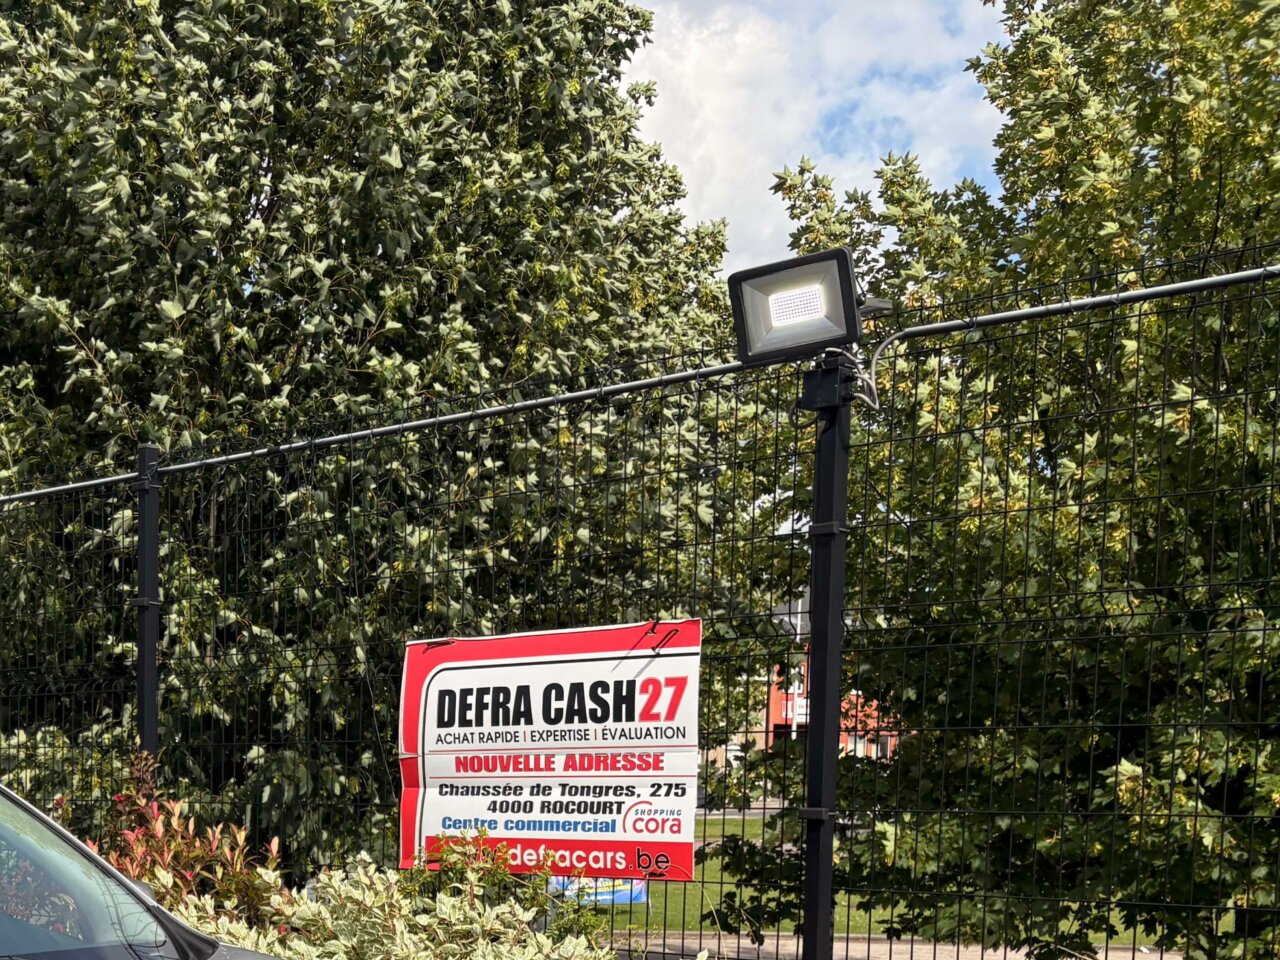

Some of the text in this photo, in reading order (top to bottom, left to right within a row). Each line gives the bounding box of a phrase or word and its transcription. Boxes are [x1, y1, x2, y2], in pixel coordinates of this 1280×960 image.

[436, 685, 534, 728] DEFRA
[435, 725, 686, 745] ACHAT RAPIDE EXPERTISE ÉVALUATION
[455, 752, 665, 773] NOUVELLE ADRESSE
[438, 783, 687, 798] Chaussée de Tongres, 275
[487, 800, 625, 815] 4000 ROCOURT
[441, 816, 616, 833] Centre commercial
[632, 817, 682, 834] cora
